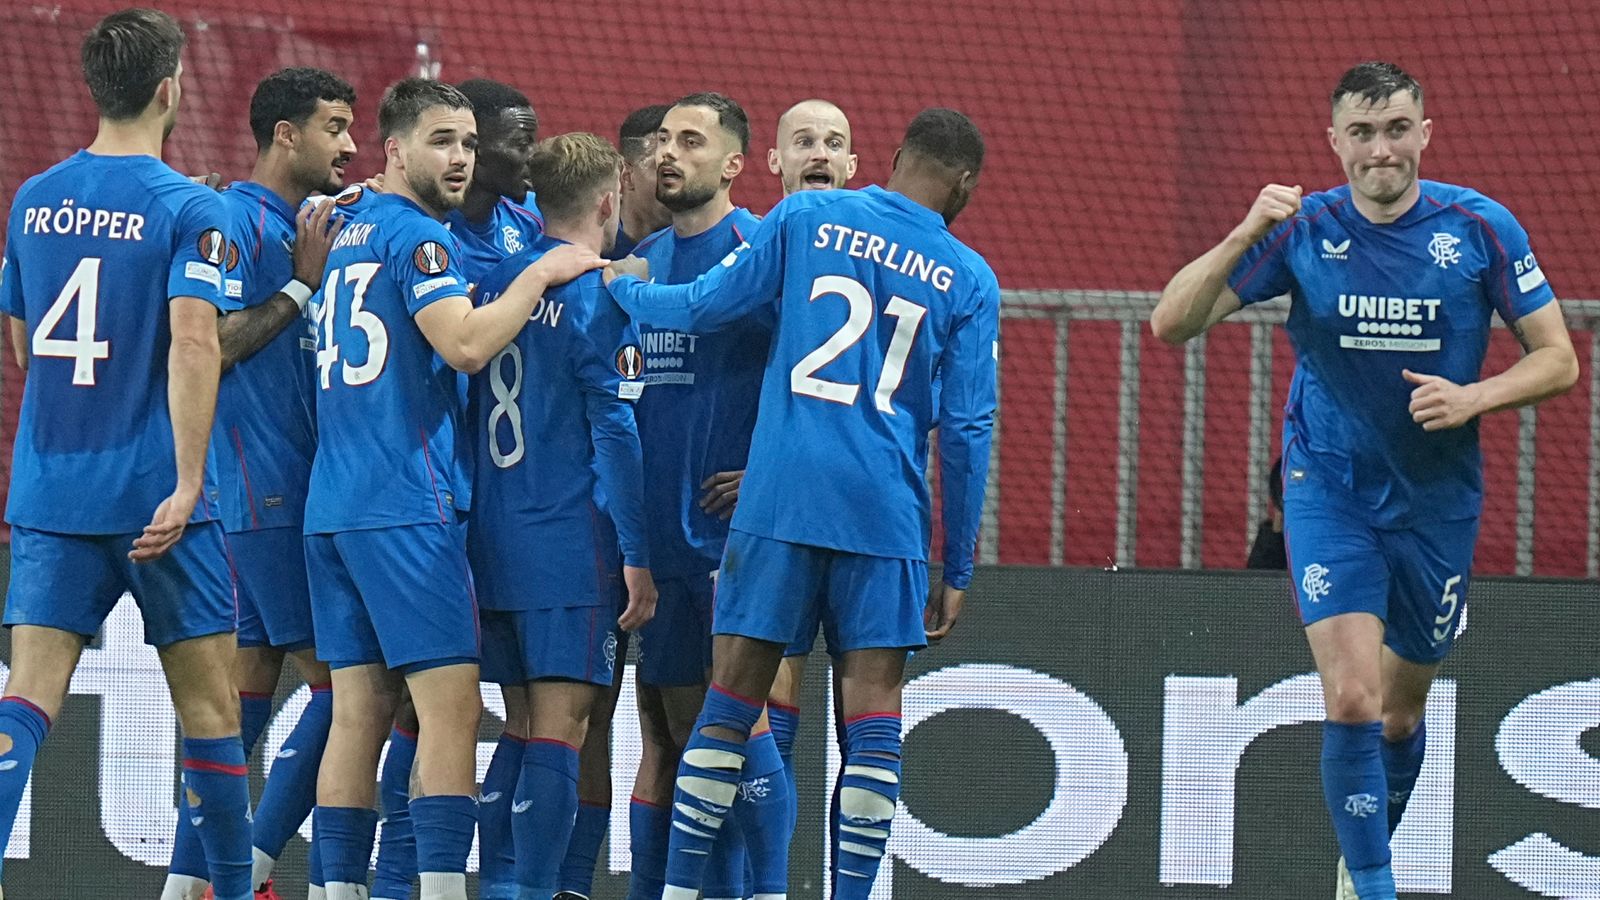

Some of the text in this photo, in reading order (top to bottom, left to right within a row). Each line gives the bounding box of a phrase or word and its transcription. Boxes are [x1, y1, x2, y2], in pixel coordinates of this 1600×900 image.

[24, 199, 145, 241] PRÖPPER
[330, 222, 377, 252] ASKIN
[814, 223, 955, 293] STERLING
[32, 257, 110, 386] 4
[316, 262, 389, 391] 43
[1338, 294, 1441, 321] UNIBET
[790, 274, 928, 415] 21
[1353, 339, 1386, 348] ZERO%
[488, 342, 525, 468] 8
[1435, 574, 1461, 624] 5
